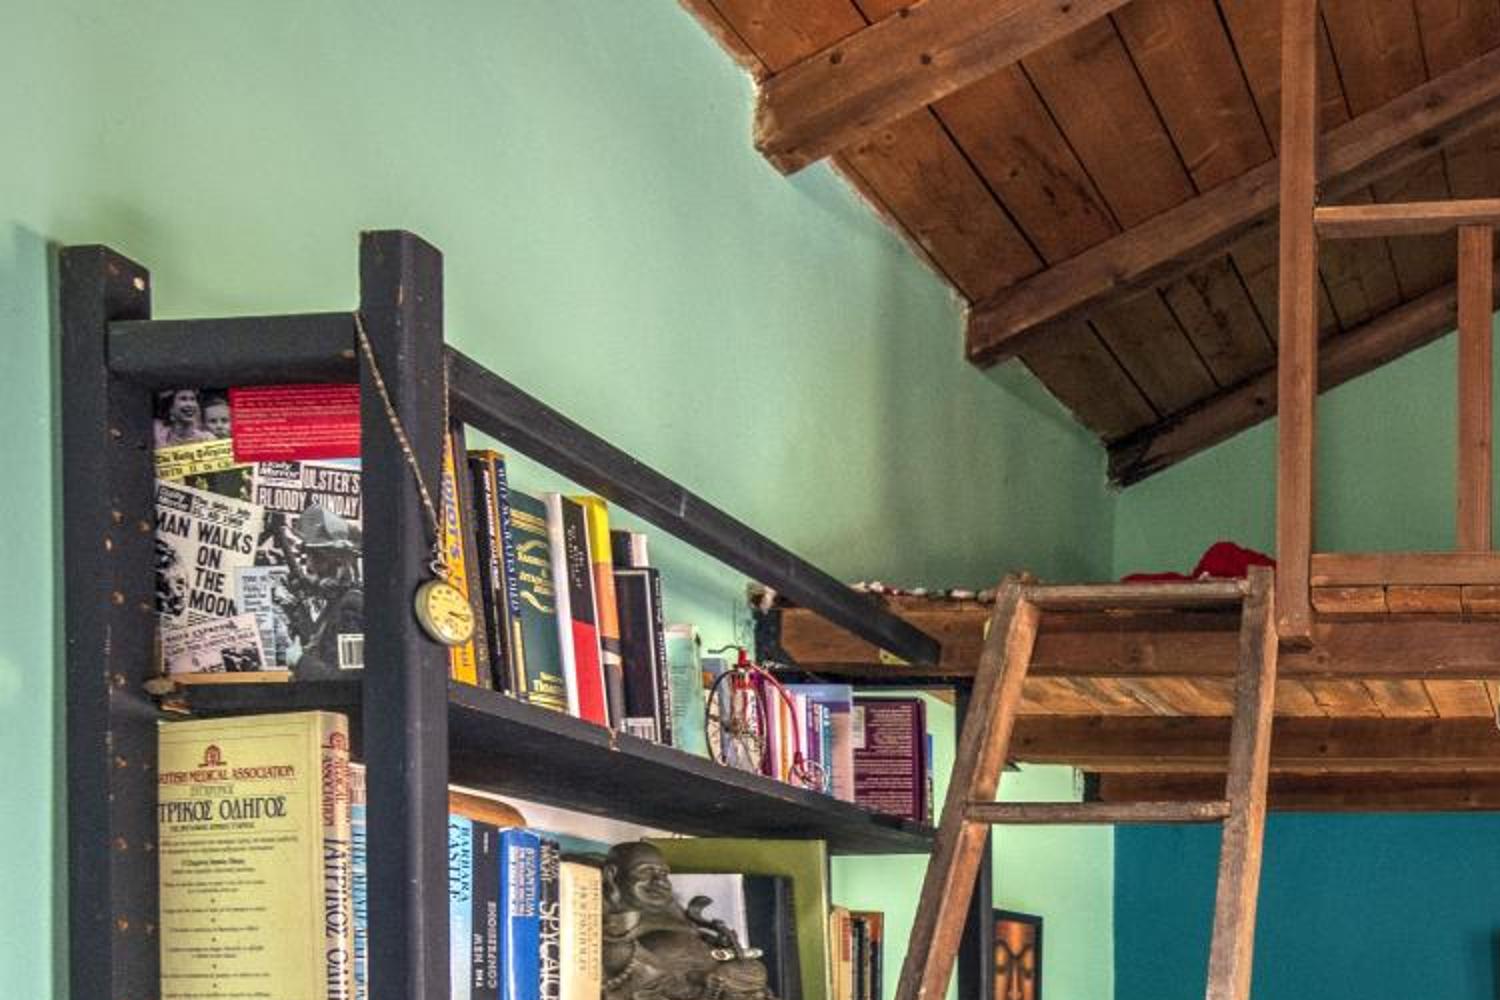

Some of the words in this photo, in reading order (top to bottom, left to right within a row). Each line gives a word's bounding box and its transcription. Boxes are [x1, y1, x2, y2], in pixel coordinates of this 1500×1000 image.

[302, 467, 361, 494] ULSTER'S
[259, 488, 307, 513] BLOODY
[311, 493, 361, 519] SUNDAY
[198, 521, 253, 555] WALKS
[197, 545, 223, 569] ON
[194, 567, 225, 593] THE
[189, 590, 239, 617] MOON
[231, 765, 295, 782] ASSOCIATION
[219, 796, 287, 821] ΟΔΗΓΟΣ
